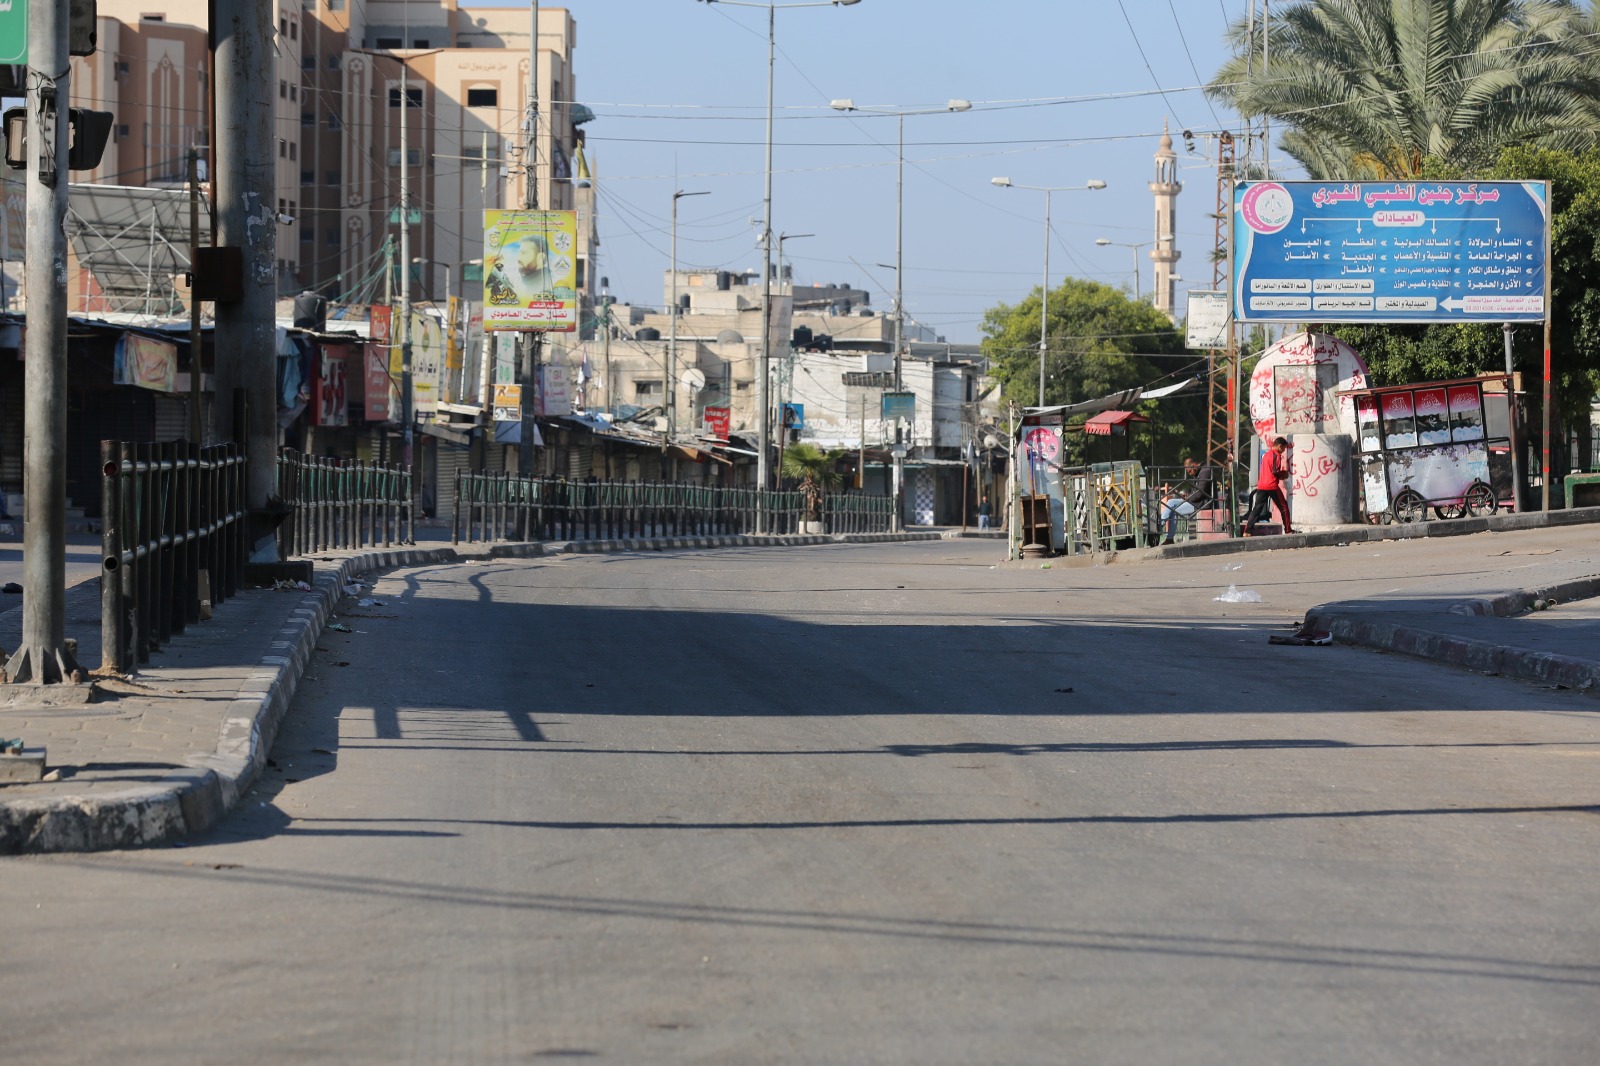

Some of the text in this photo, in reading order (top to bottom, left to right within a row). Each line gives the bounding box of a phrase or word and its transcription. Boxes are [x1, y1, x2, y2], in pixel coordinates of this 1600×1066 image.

[1312, 184, 1500, 208] مركز جنين الطبي الخيري
[1377, 212, 1419, 225] العيادات
[1283, 238, 1322, 248] العيون
[1341, 238, 1377, 248] العظام
[1393, 237, 1451, 248] المسالك البولية
[1498, 238, 1522, 247] النساء
[1284, 250, 1319, 261] الأسنان
[1427, 250, 1452, 261] النفسية
[1468, 251, 1522, 261] الجراحة العامة
[1340, 264, 1375, 275] الأطفال
[1393, 279, 1407, 289] الوزن
[1432, 279, 1451, 289] التغذية
[1467, 279, 1499, 290] الحنجرة
[523, 310, 545, 320] حسين
